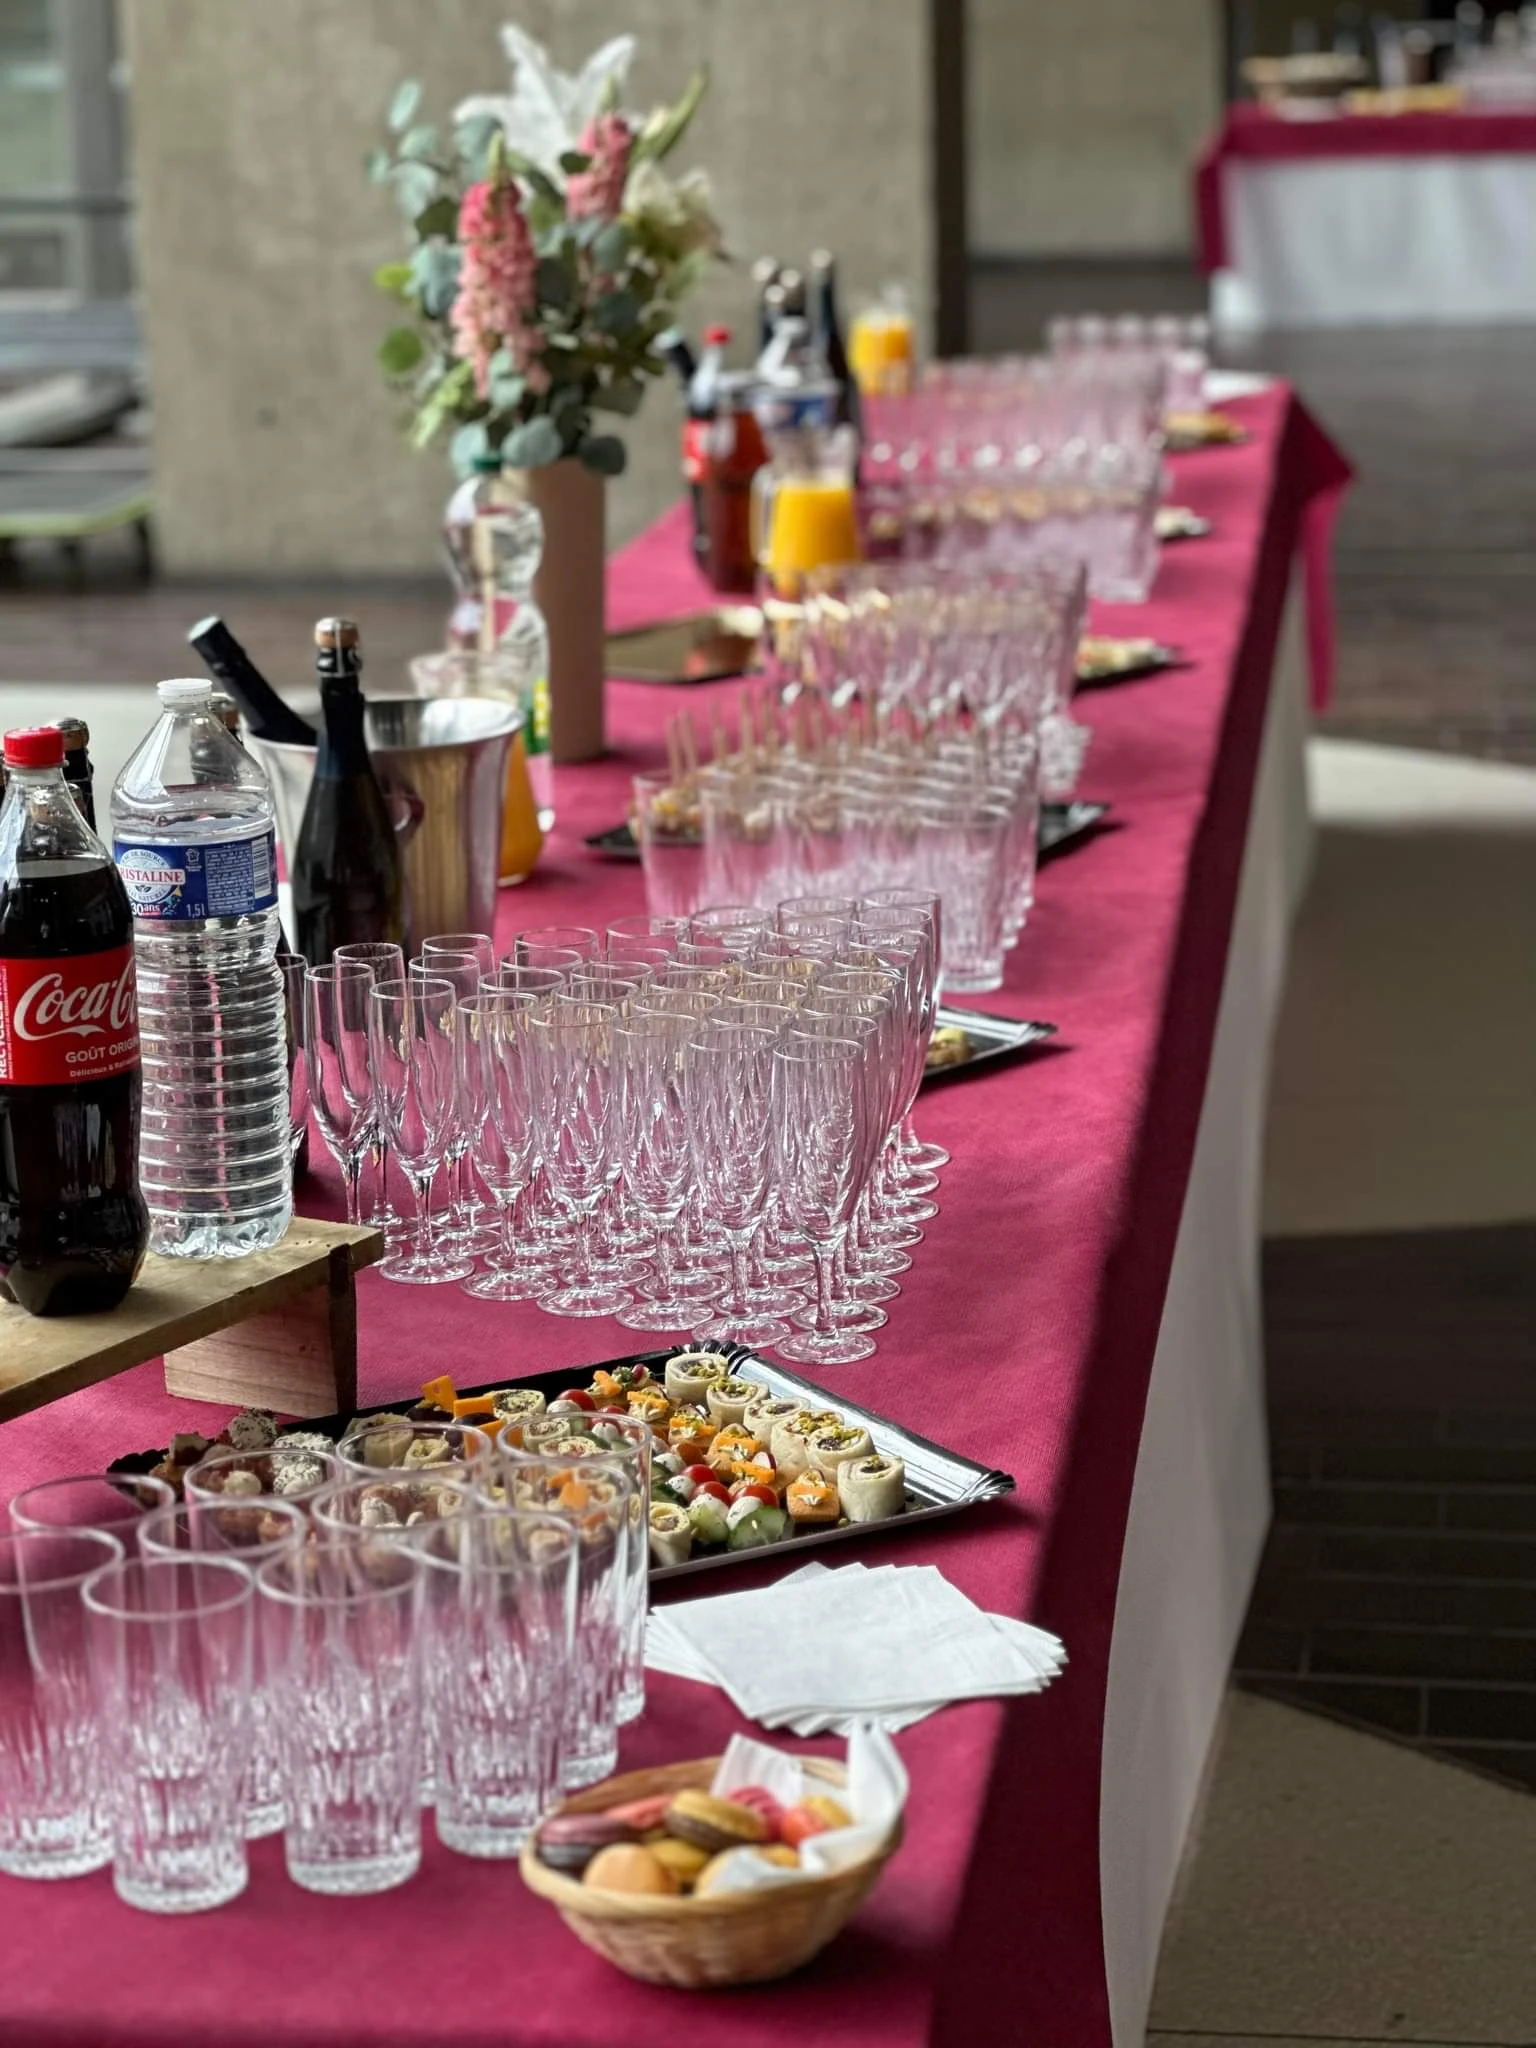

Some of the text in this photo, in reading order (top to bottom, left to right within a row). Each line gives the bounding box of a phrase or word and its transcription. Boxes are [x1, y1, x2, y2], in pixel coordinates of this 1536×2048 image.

[118, 867, 183, 883] RISTALINE
[65, 1046, 106, 1063] GOÛT
[109, 1036, 139, 1056] ORIG
